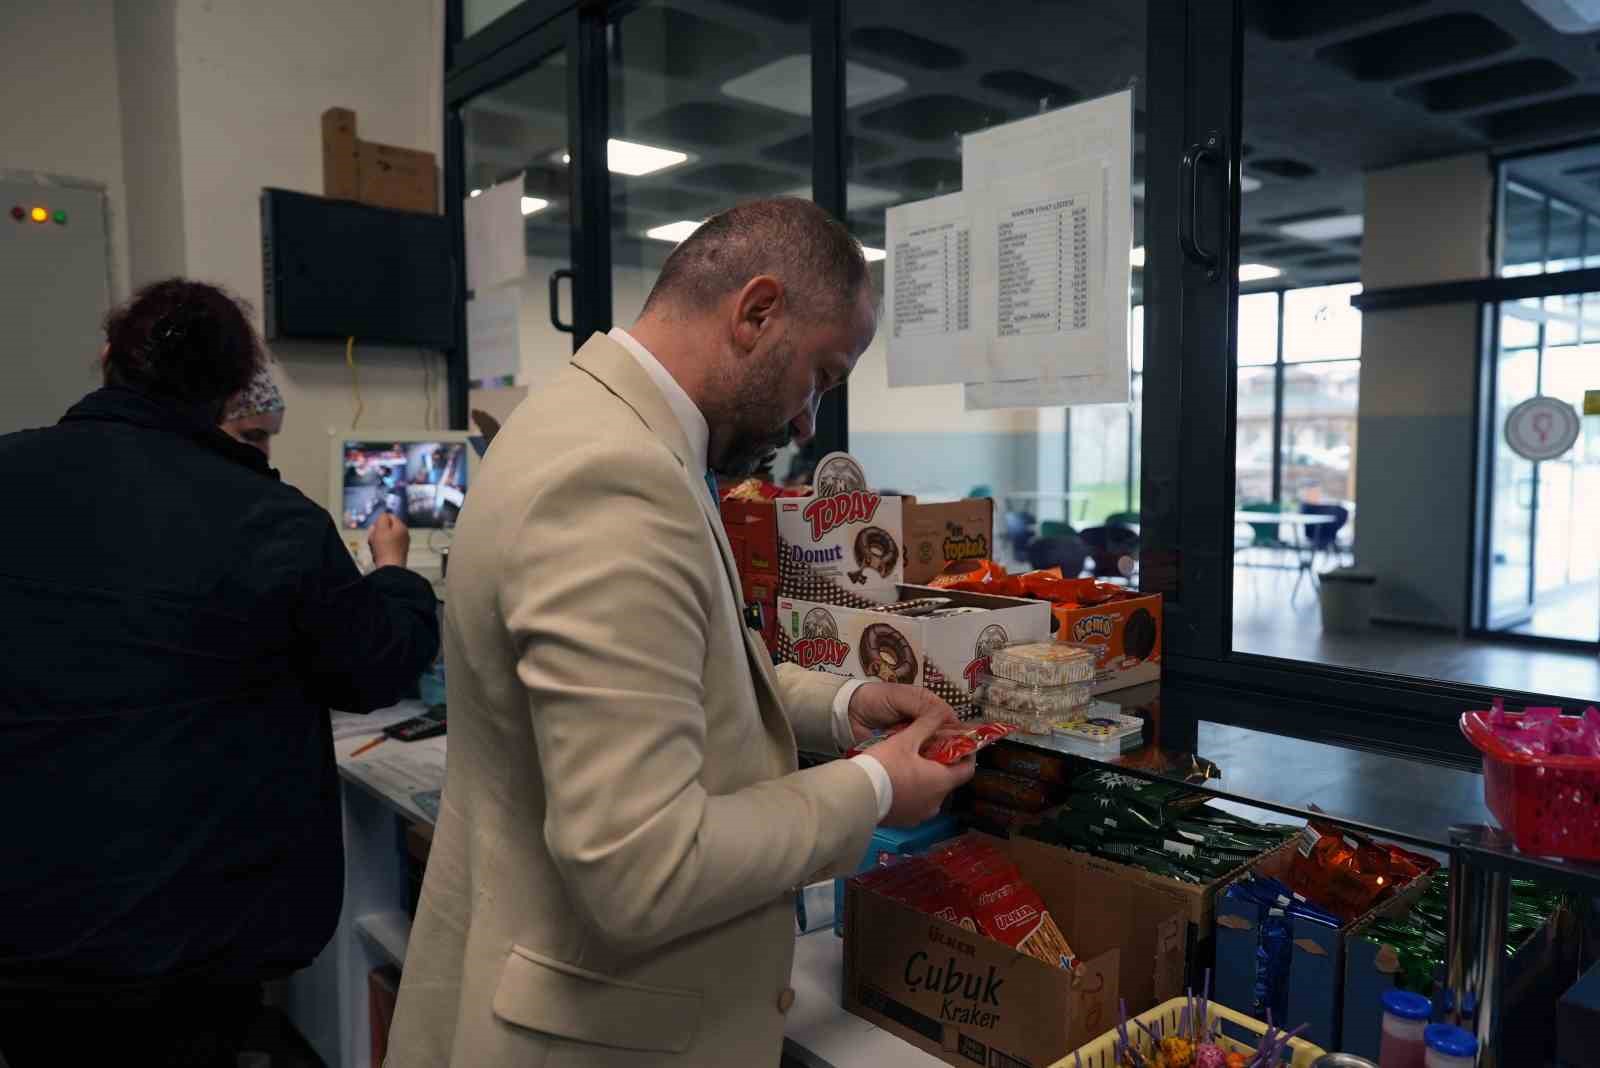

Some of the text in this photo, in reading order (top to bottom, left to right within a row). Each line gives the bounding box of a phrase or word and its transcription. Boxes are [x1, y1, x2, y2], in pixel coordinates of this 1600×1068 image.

[803, 490, 881, 542] TODAY
[791, 545, 842, 563] Donut
[793, 637, 850, 669] TODAY
[994, 905, 1036, 930] ÜLKER
[904, 951, 1003, 1006] Çubuk
[940, 1000, 1001, 1029] Kraker
